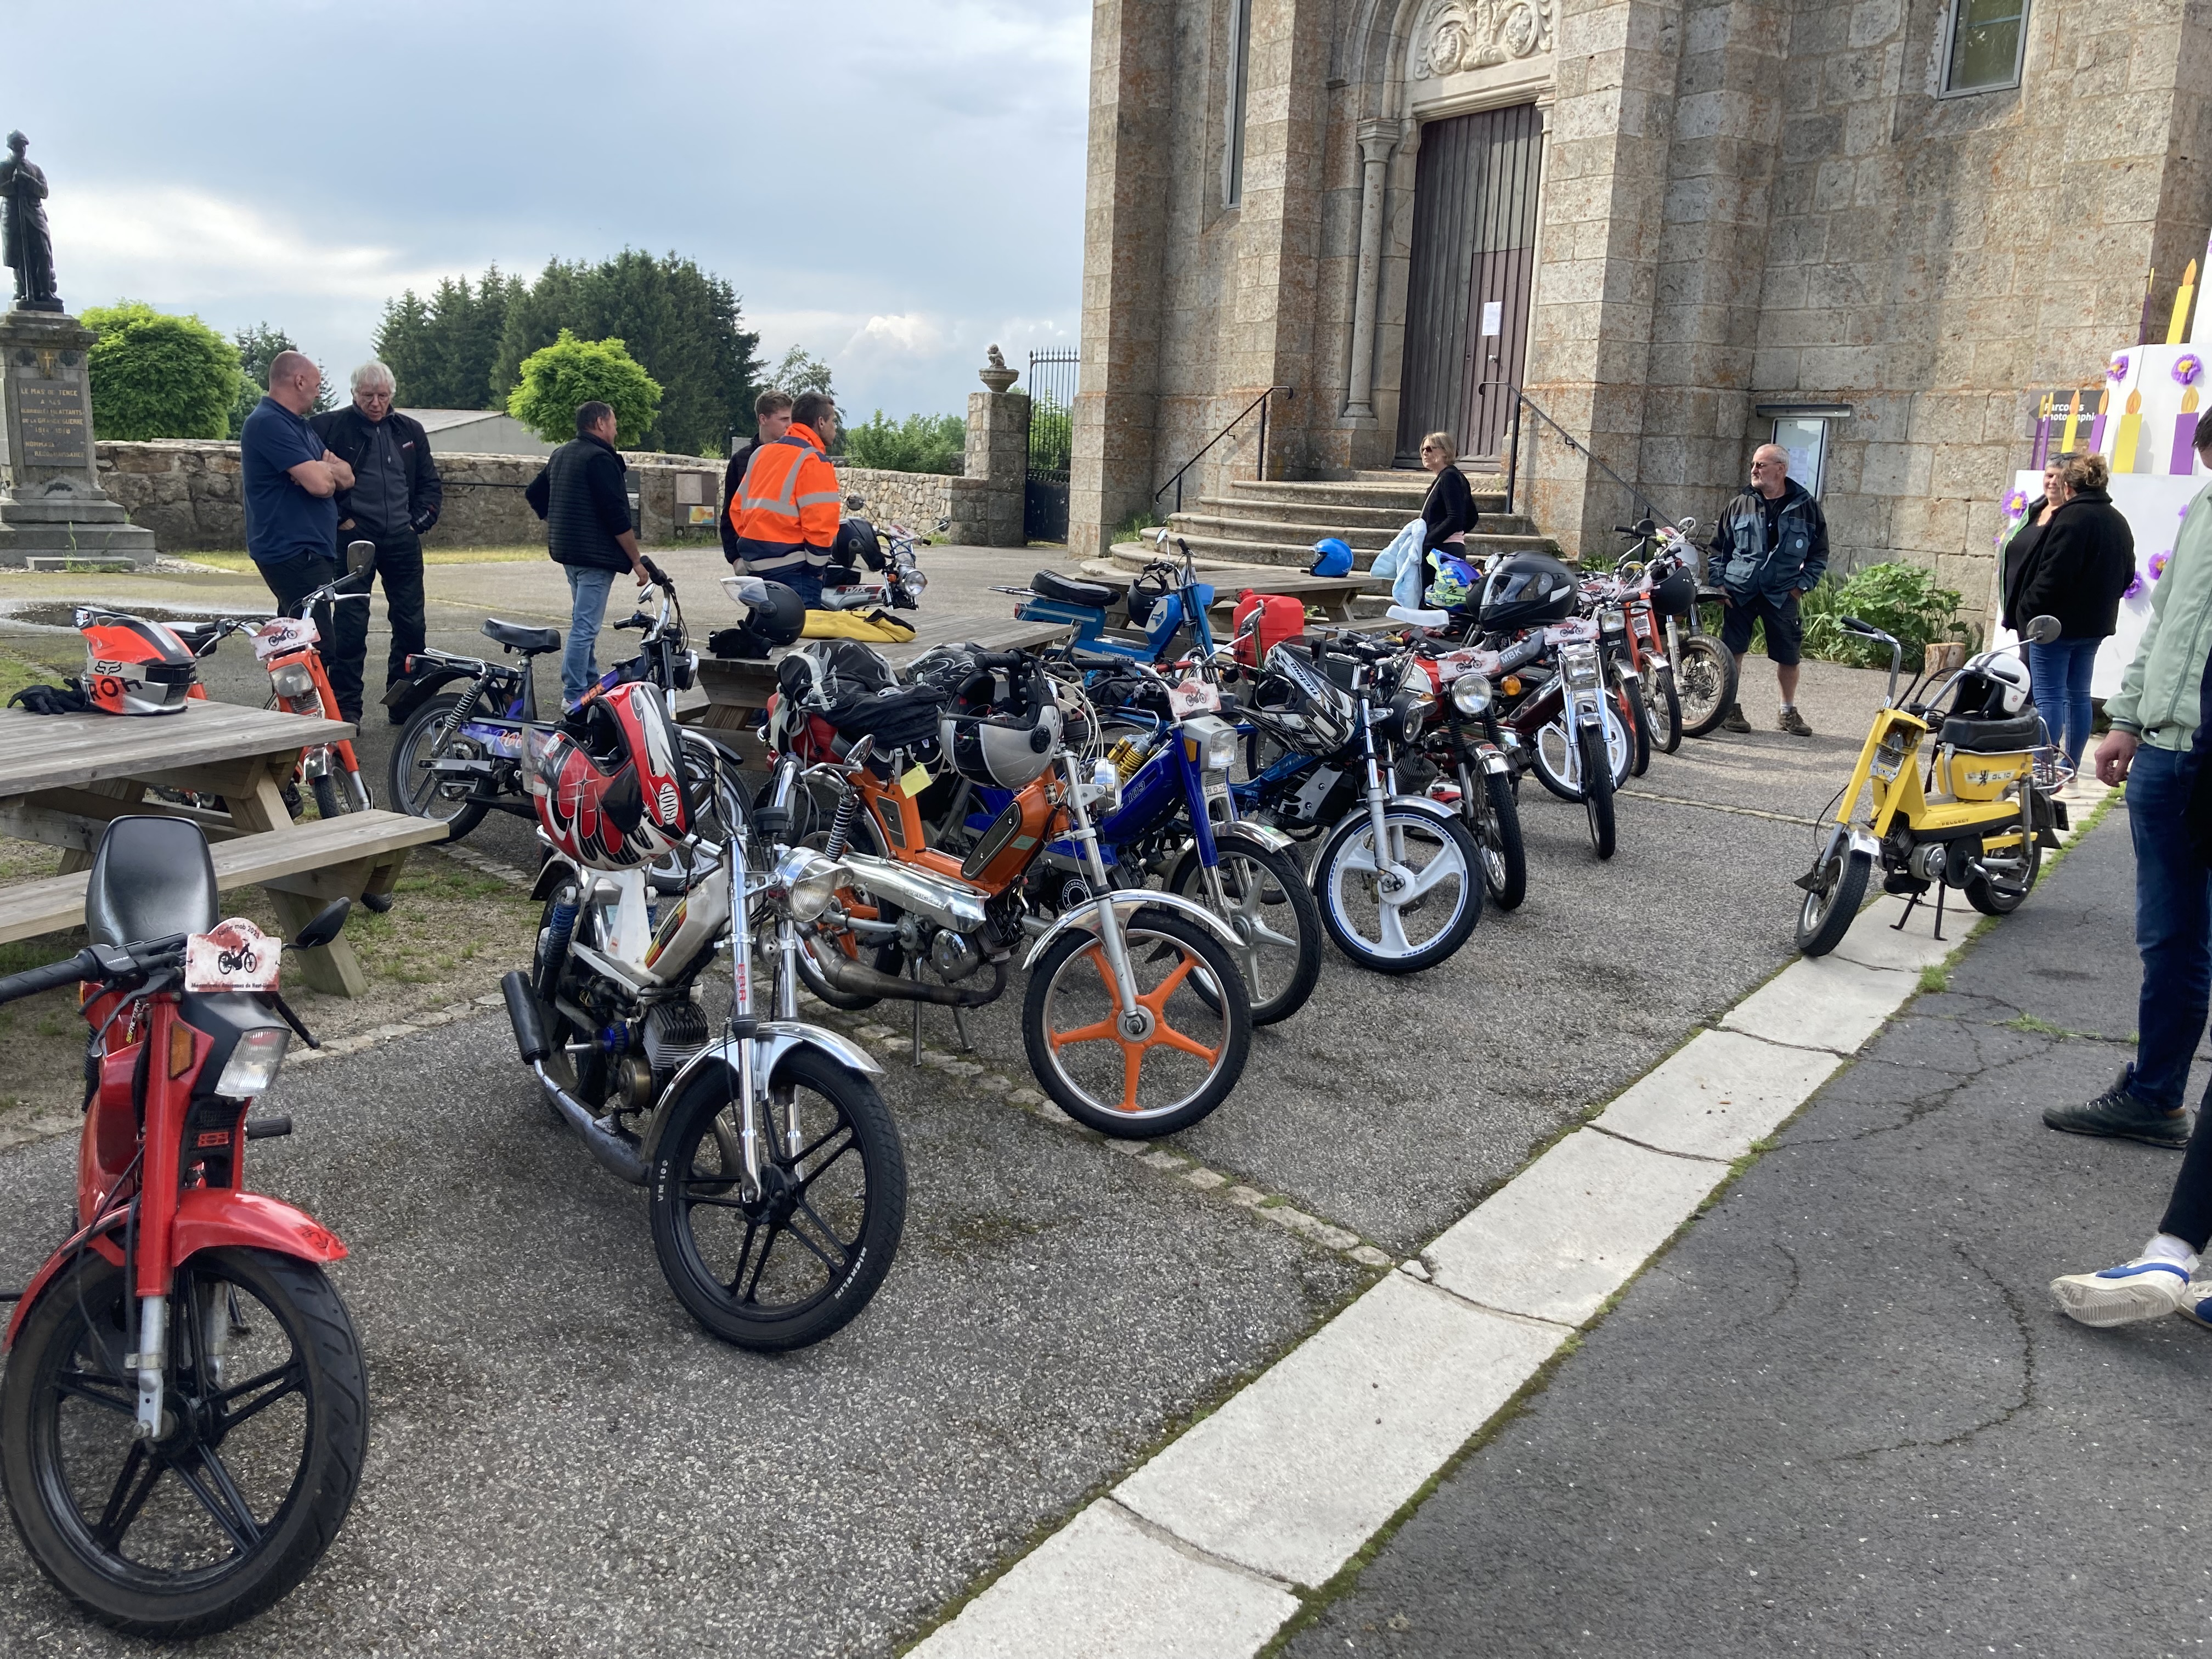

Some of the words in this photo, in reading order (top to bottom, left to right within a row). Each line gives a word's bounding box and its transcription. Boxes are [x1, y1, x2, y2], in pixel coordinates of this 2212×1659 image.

[1500, 647, 1522, 664] MBK
[1290, 663, 1318, 696] TECHNO
[580, 681, 606, 706] MBK
[1128, 780, 1146, 803] 103
[1209, 785, 1223, 793] 103
[1942, 818, 1968, 826] PEUGEOT
[247, 926, 259, 939] 2023
[659, 1159, 669, 1180] 100
[658, 1184, 664, 1202] VM
[834, 1246, 867, 1300] MICHELIN
